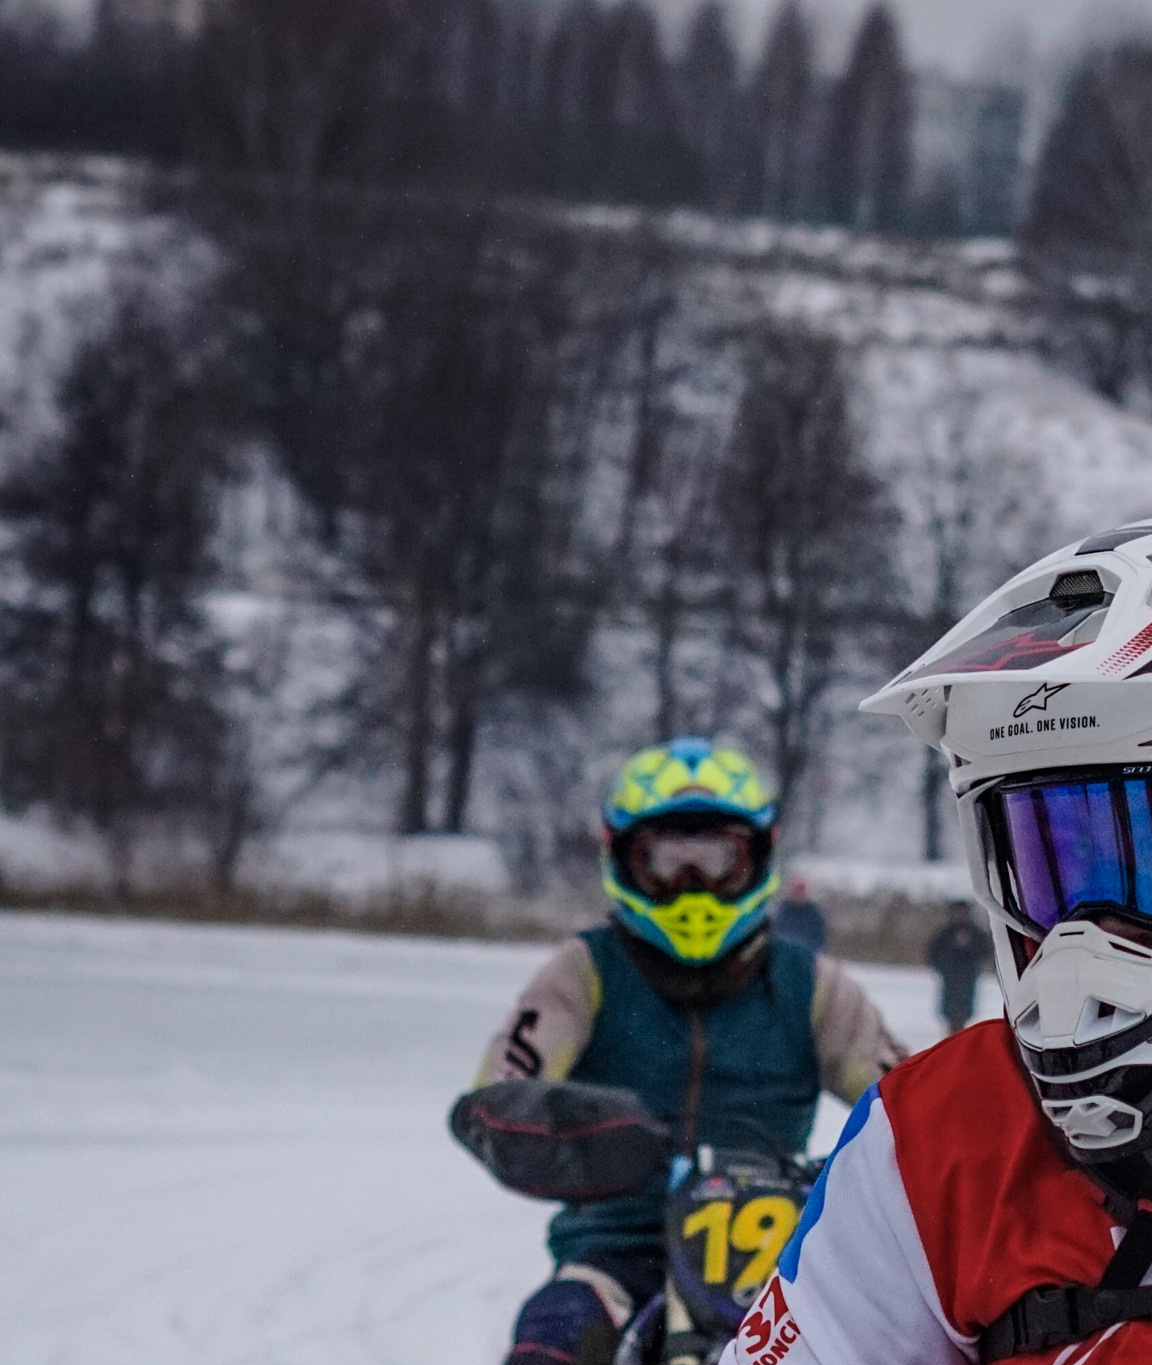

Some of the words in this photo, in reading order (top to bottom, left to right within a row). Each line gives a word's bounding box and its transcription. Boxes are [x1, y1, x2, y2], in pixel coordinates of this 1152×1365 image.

[989, 726, 1005, 740] ONE
[1008, 722, 1034, 737] GOAL.
[1037, 718, 1056, 732] ONE
[1059, 715, 1100, 730] VISION.
[683, 1195, 799, 1292] 19
